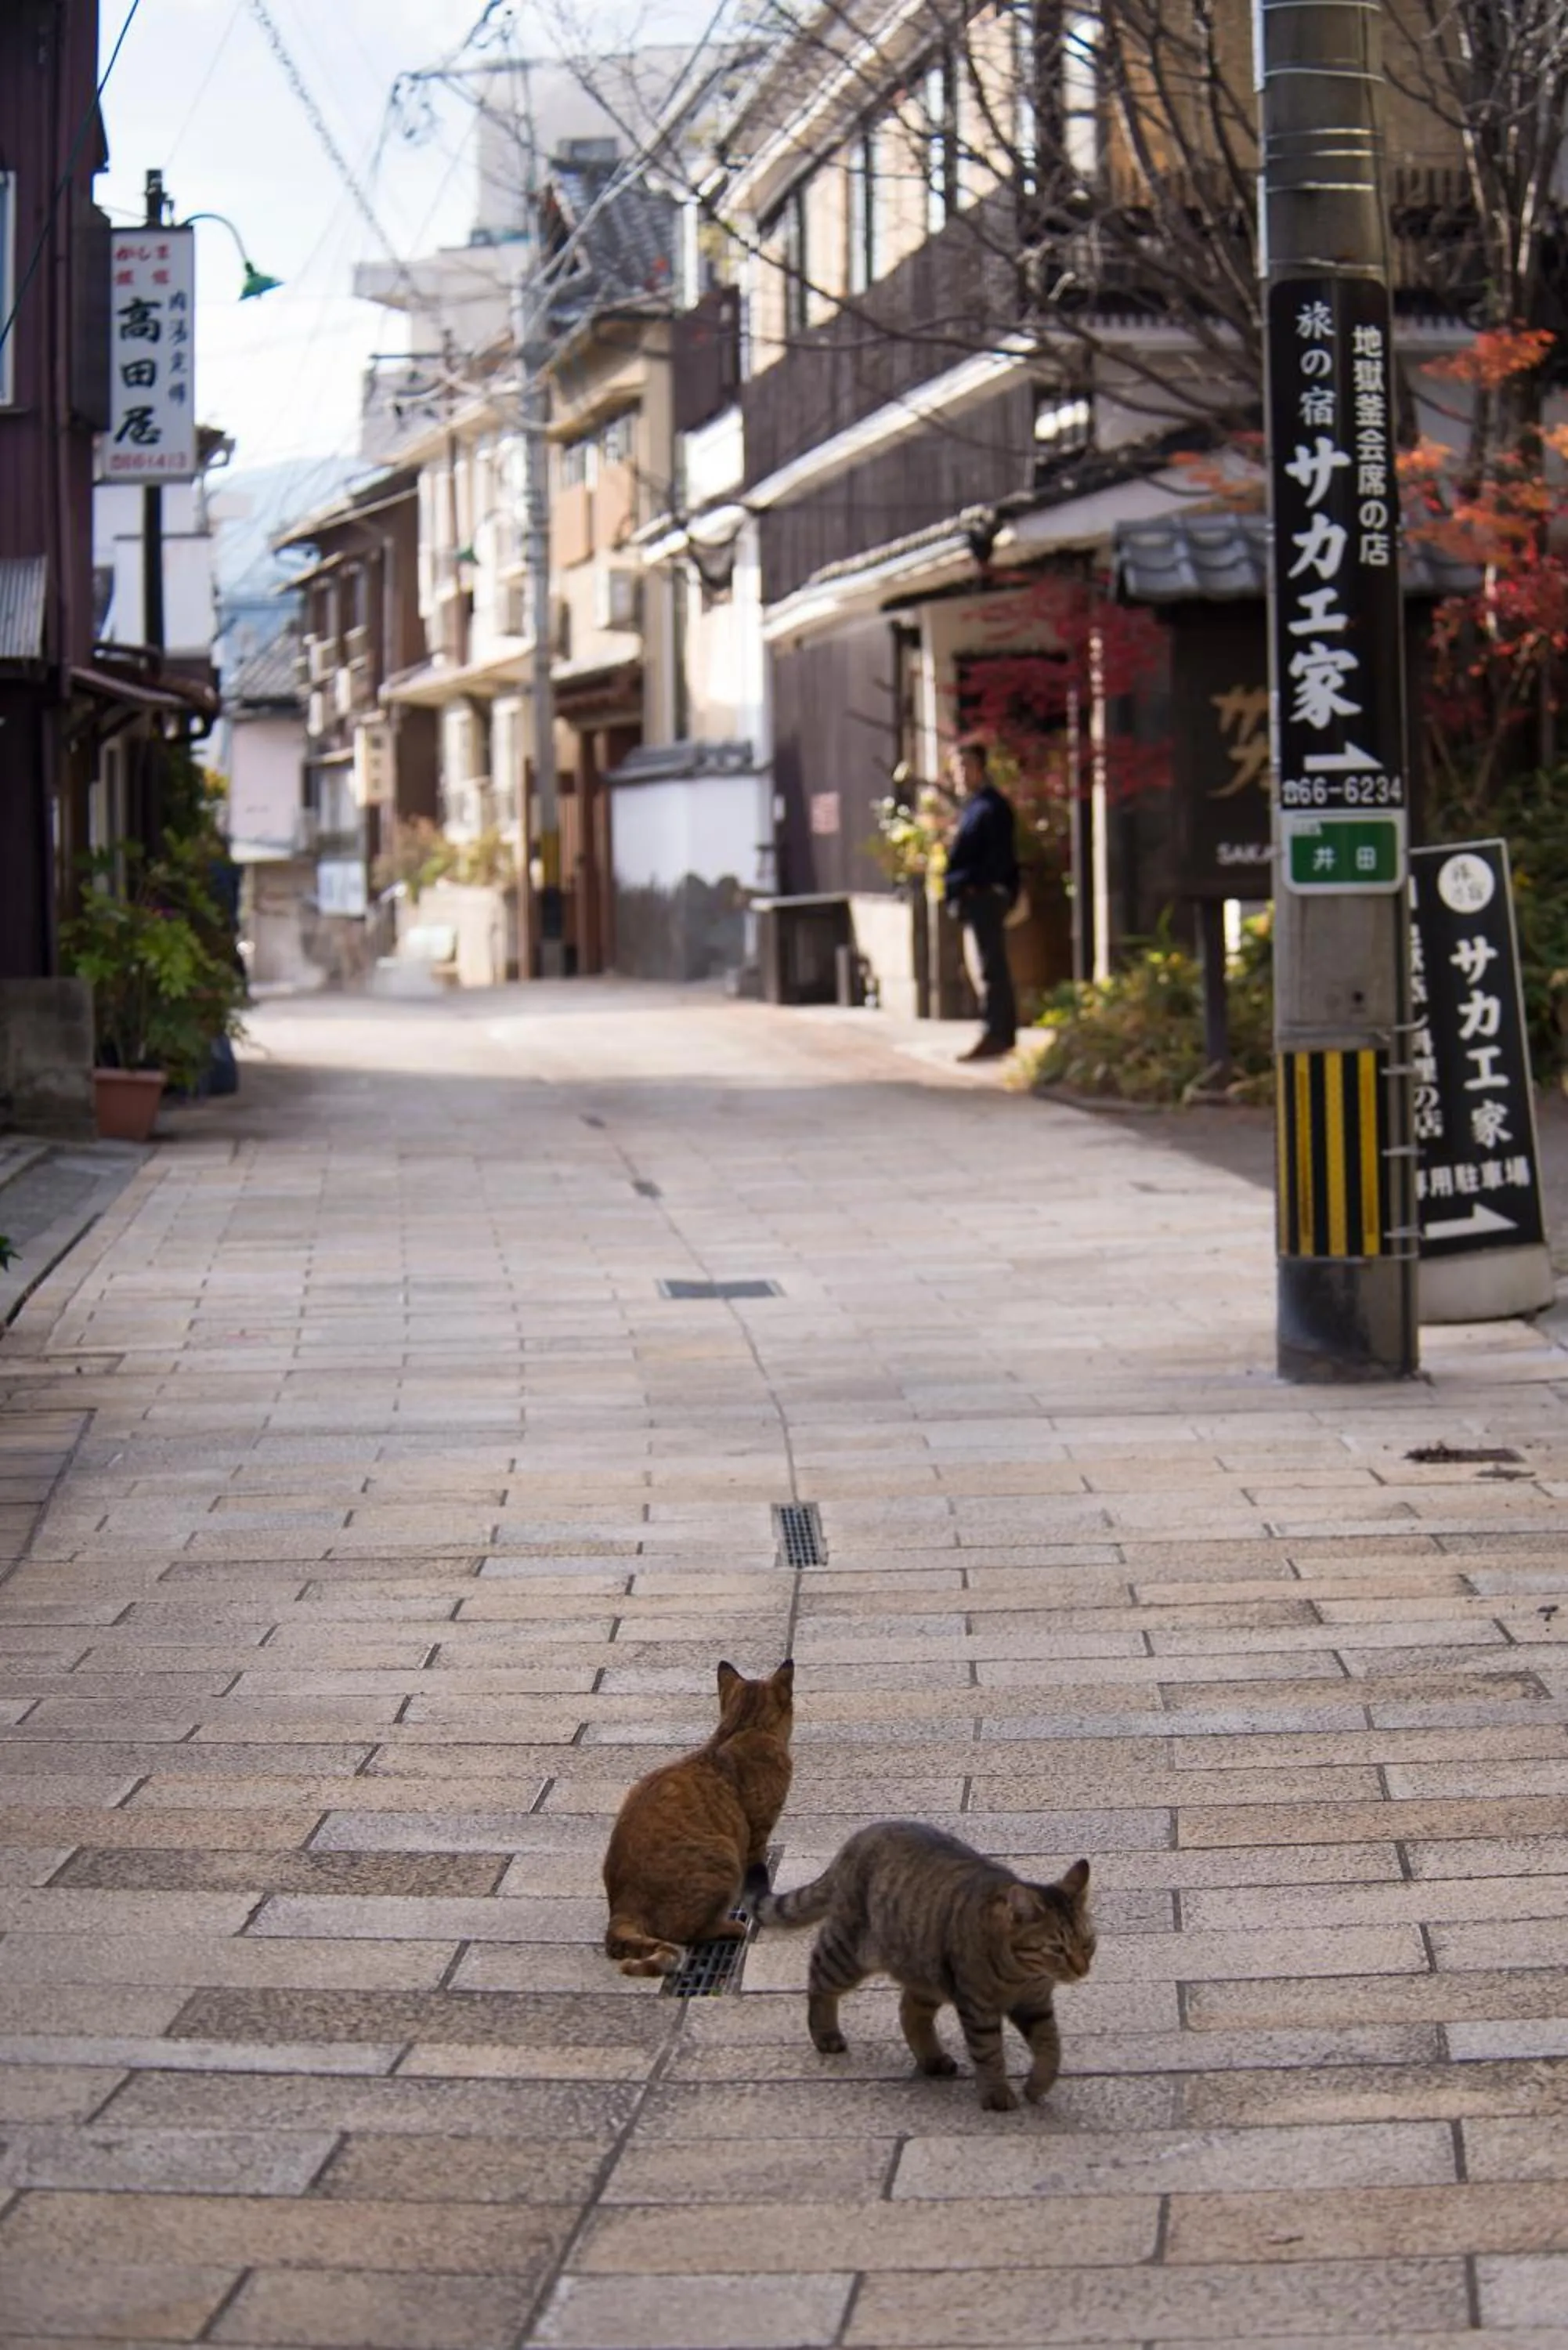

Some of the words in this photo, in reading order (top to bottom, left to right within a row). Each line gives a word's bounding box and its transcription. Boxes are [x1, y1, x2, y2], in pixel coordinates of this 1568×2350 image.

[1296, 301, 1336, 426] 旅の宿
[1313, 845, 1376, 871] 井田
